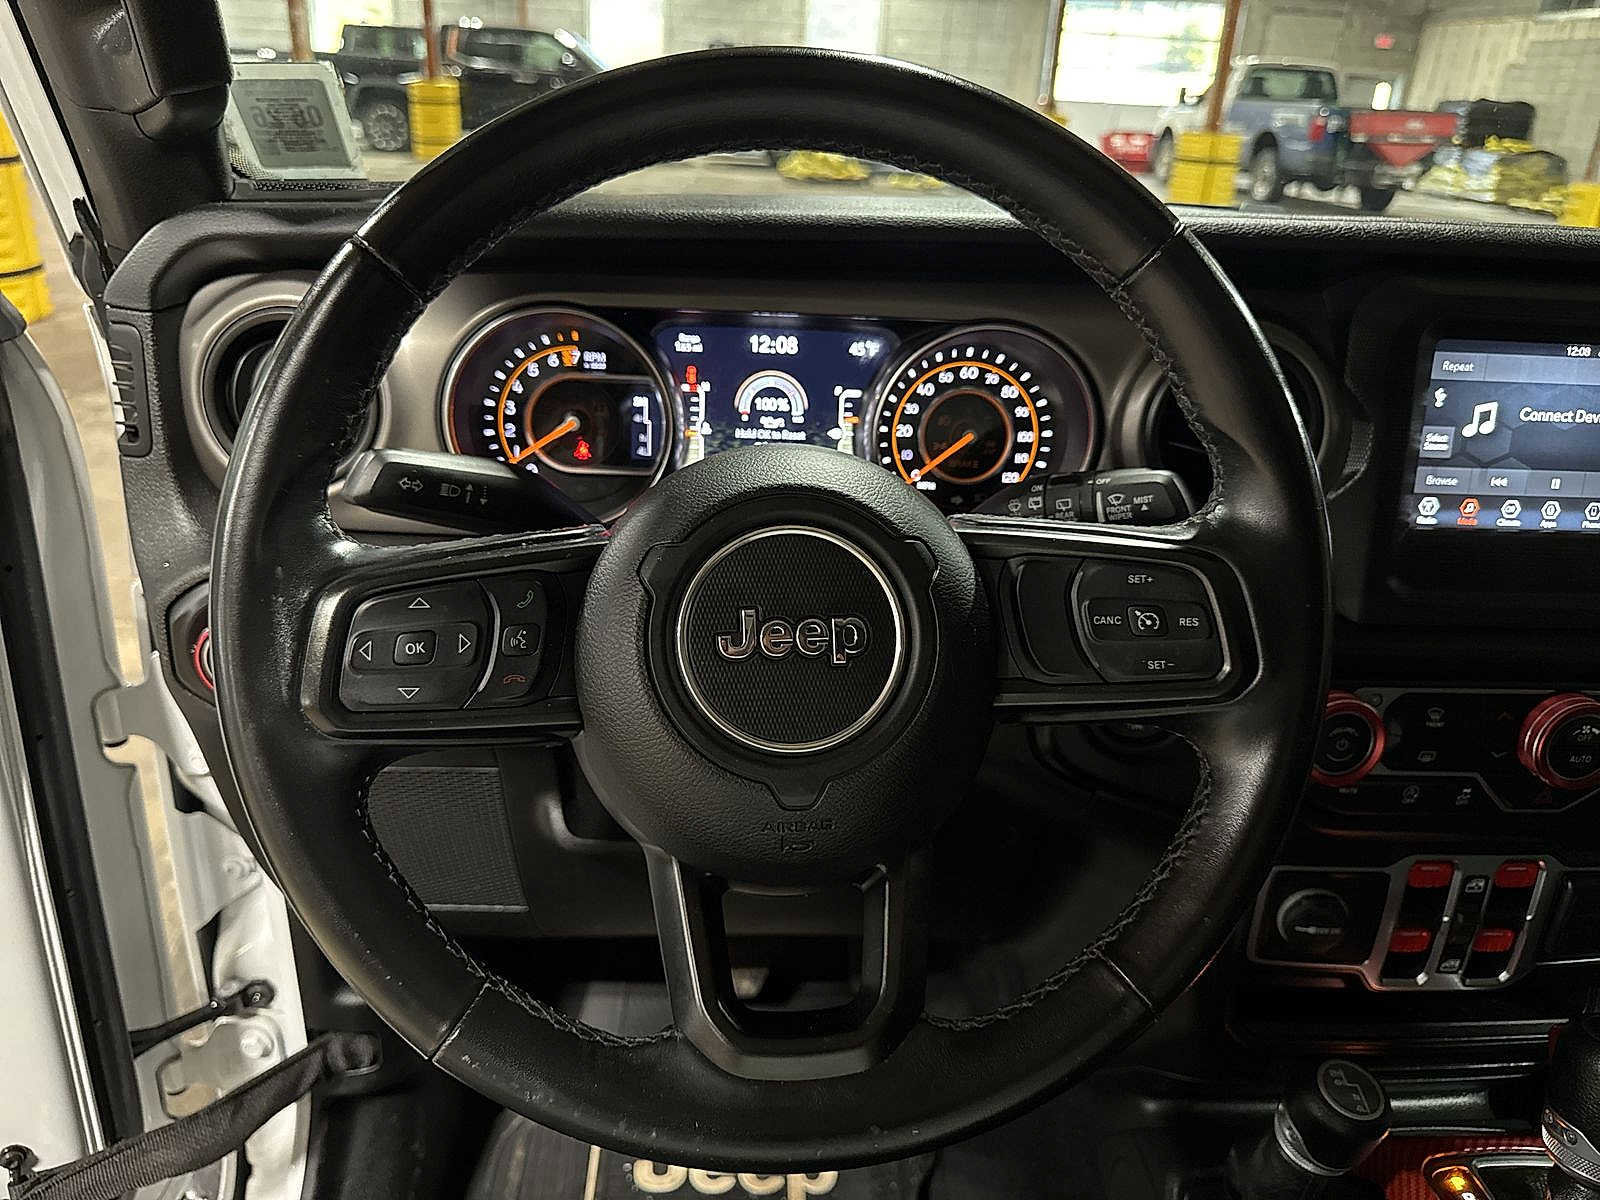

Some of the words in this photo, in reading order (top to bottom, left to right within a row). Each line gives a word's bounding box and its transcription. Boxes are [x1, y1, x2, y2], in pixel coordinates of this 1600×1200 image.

[749, 334, 799, 354] 12:08
[547, 353, 560, 368] 6
[1442, 360, 1475, 373] Repeat
[959, 366, 980, 380] 60
[916, 382, 936, 397] 40
[504, 400, 517, 416] 3
[754, 396, 790, 412] 100%
[1519, 407, 1574, 423] Connect
[504, 422, 517, 438] 2
[757, 428, 771, 440] OK
[895, 424, 914, 438] 20
[1425, 474, 1459, 486] Browse
[1133, 495, 1154, 505] MIST
[1106, 505, 1133, 515] FRONT
[1093, 615, 1122, 625] CANC
[1179, 617, 1200, 627] RES
[717, 609, 868, 664] Jeep
[405, 641, 426, 656] OK
